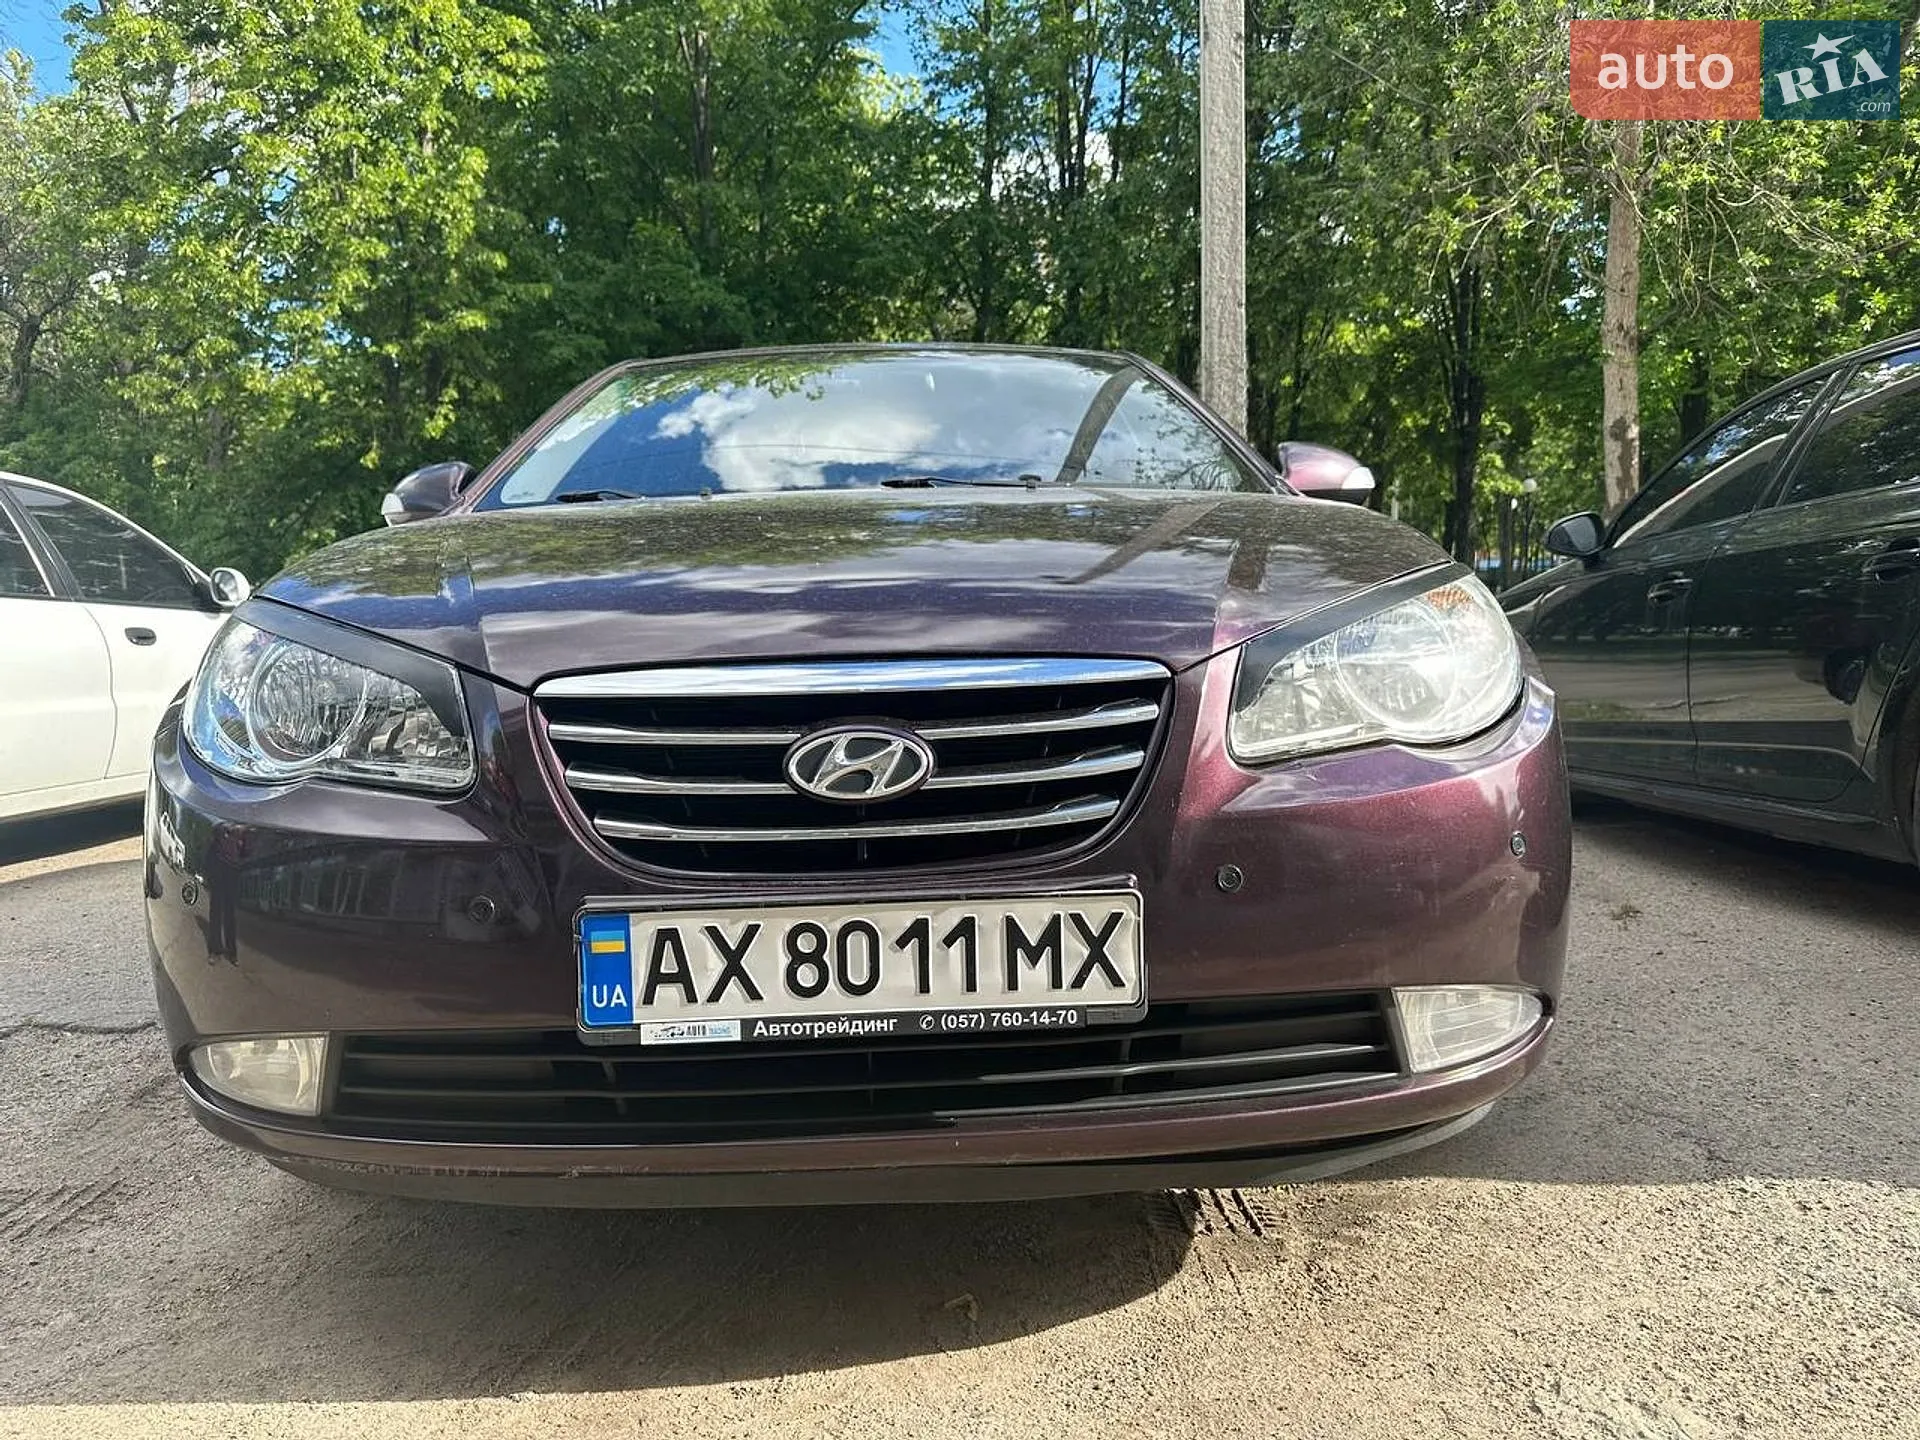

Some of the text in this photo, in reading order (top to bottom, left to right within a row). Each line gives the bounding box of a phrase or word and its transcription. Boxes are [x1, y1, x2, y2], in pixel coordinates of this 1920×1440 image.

[642, 911, 1127, 1005] AX 8011 MX
[592, 985, 627, 1008] UA
[753, 1016, 898, 1038] Автотрейдинг
[940, 1009, 1078, 1030] (057) 760-14-70
